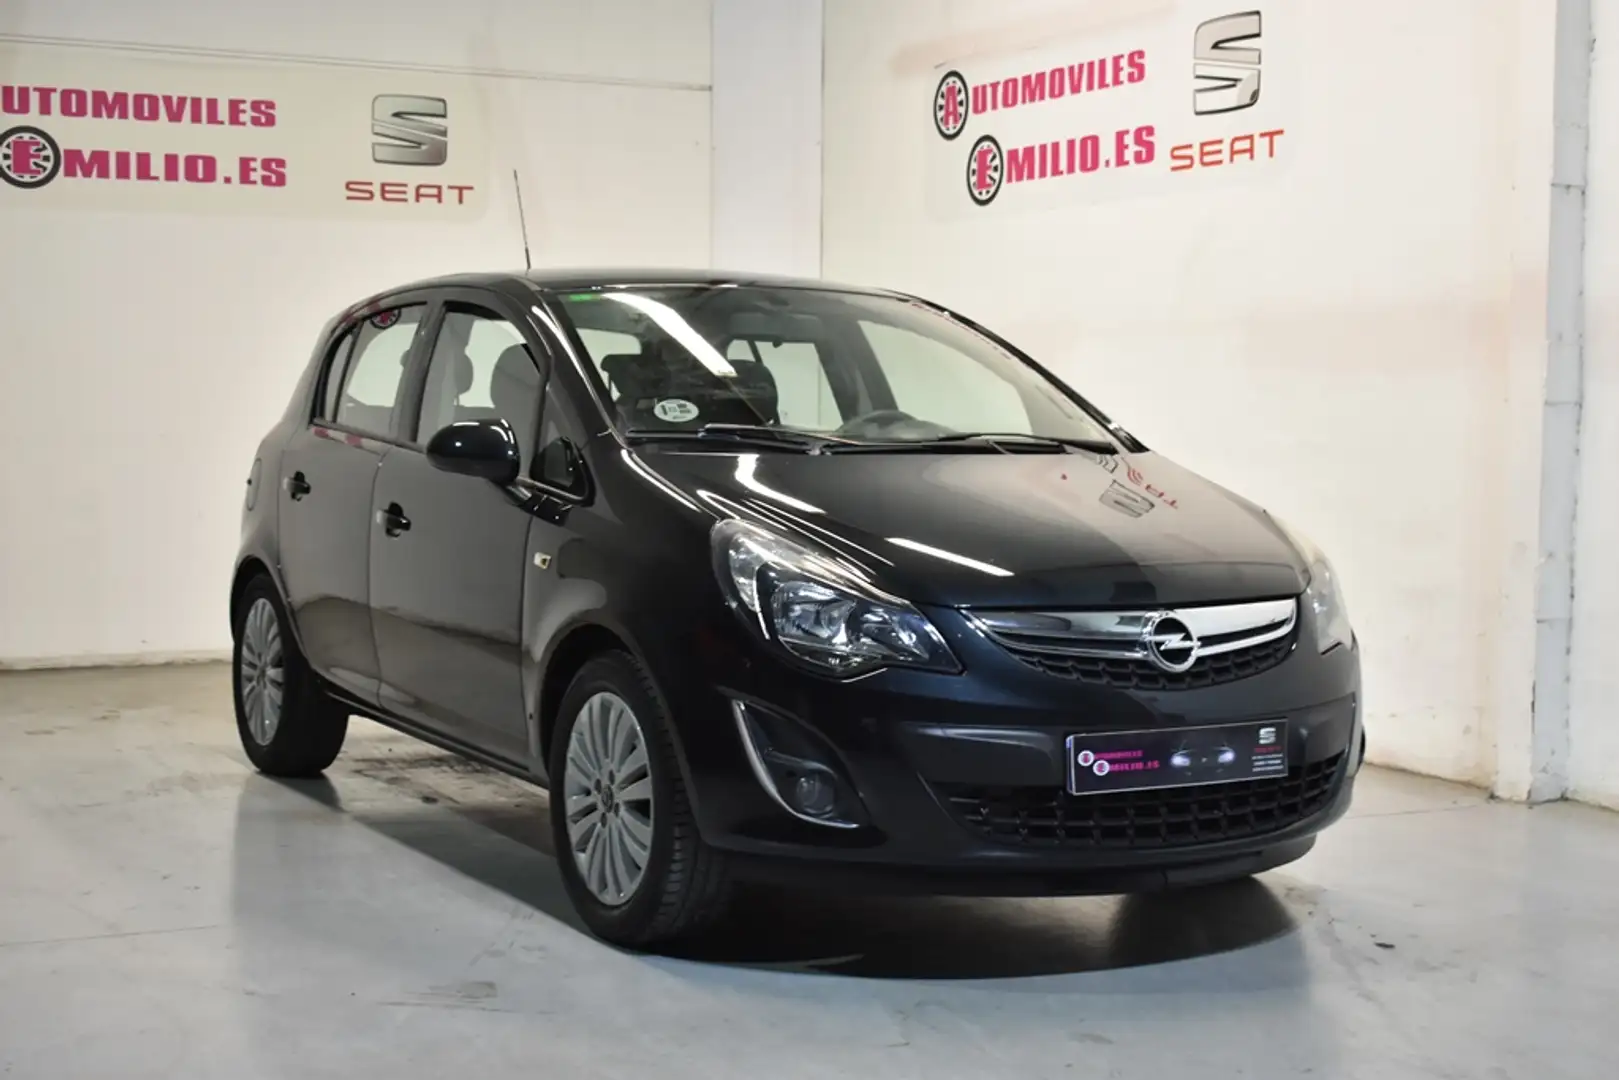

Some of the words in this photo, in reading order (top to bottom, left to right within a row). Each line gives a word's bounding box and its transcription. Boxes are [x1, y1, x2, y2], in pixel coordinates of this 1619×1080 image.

[1, 86, 277, 128] UTOMOVILES
[943, 50, 1146, 128] AUTOMOVILES
[12, 139, 287, 187] EMILIO.ES
[975, 125, 1155, 191] EMILIO.ES
[1170, 129, 1284, 172] SEAT
[345, 181, 474, 205] SEAT
